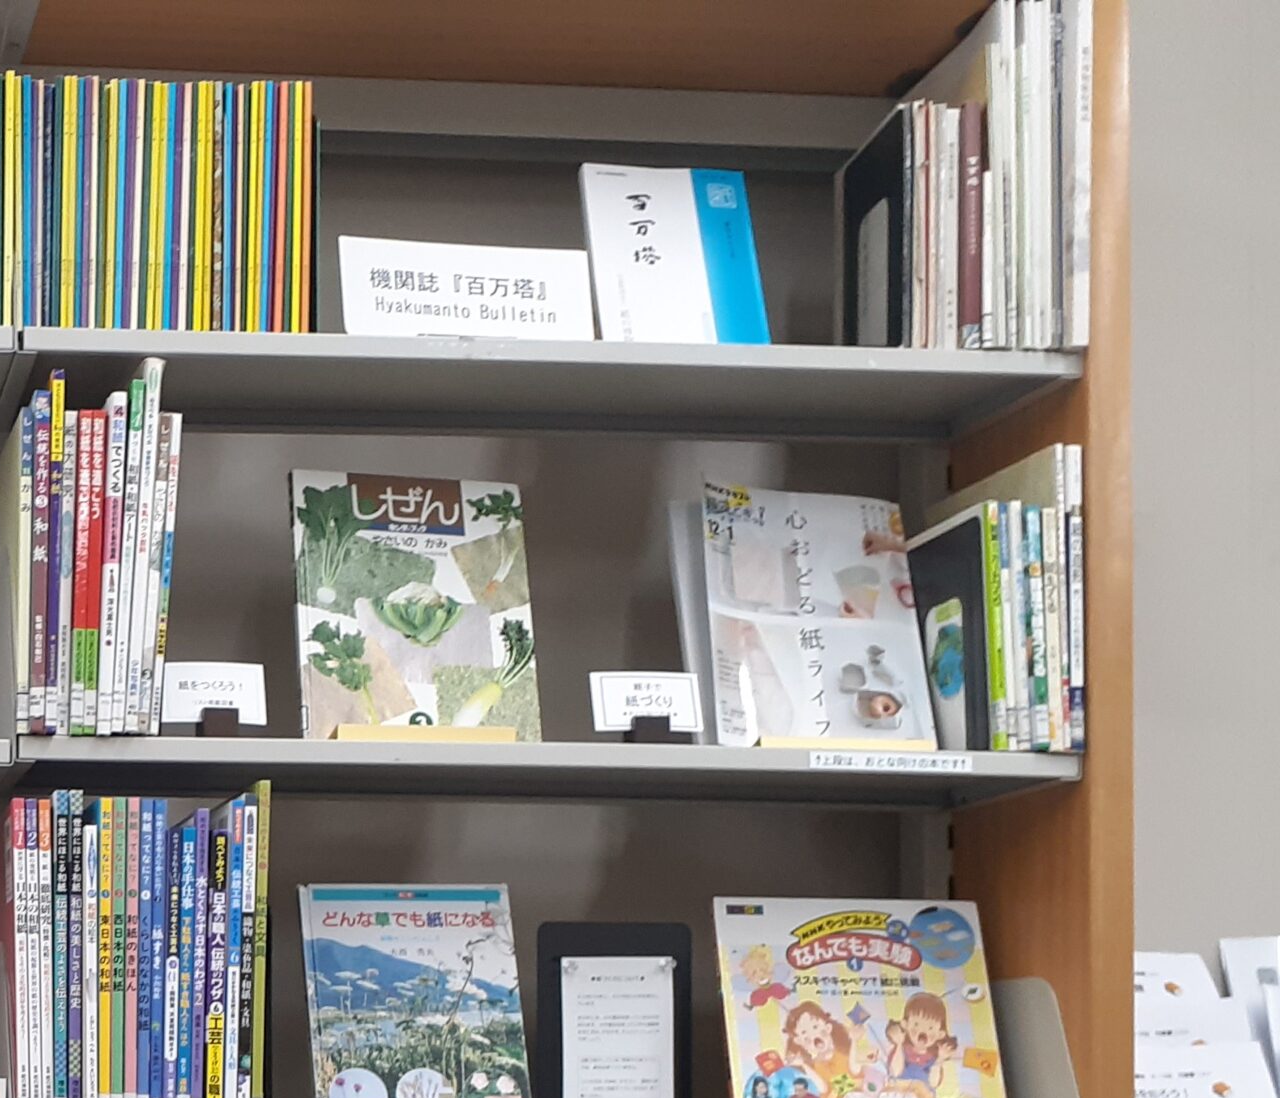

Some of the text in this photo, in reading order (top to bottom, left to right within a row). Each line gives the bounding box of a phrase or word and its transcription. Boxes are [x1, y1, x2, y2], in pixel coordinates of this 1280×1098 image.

[370, 267, 547, 301] 機関誌『百万塔』
[374, 296, 557, 324] Hyakumanto Bulletin
[351, 483, 459, 526] しぜん
[785, 510, 831, 736] 心おどる紙ライフ
[625, 695, 673, 708] 紙づくり
[56, 818, 68, 893] 世界にほこる和紙
[71, 818, 83, 893] 世界にほこる和紙
[181, 841, 195, 910] 日本の手仕事
[99, 915, 111, 992] 東日本の和紙
[113, 915, 124, 992] 西日本の和紙
[127, 915, 139, 992] 和紙のきほん
[322, 911, 496, 928] どんな草でも紙になる
[791, 936, 913, 968] なんでも実験
